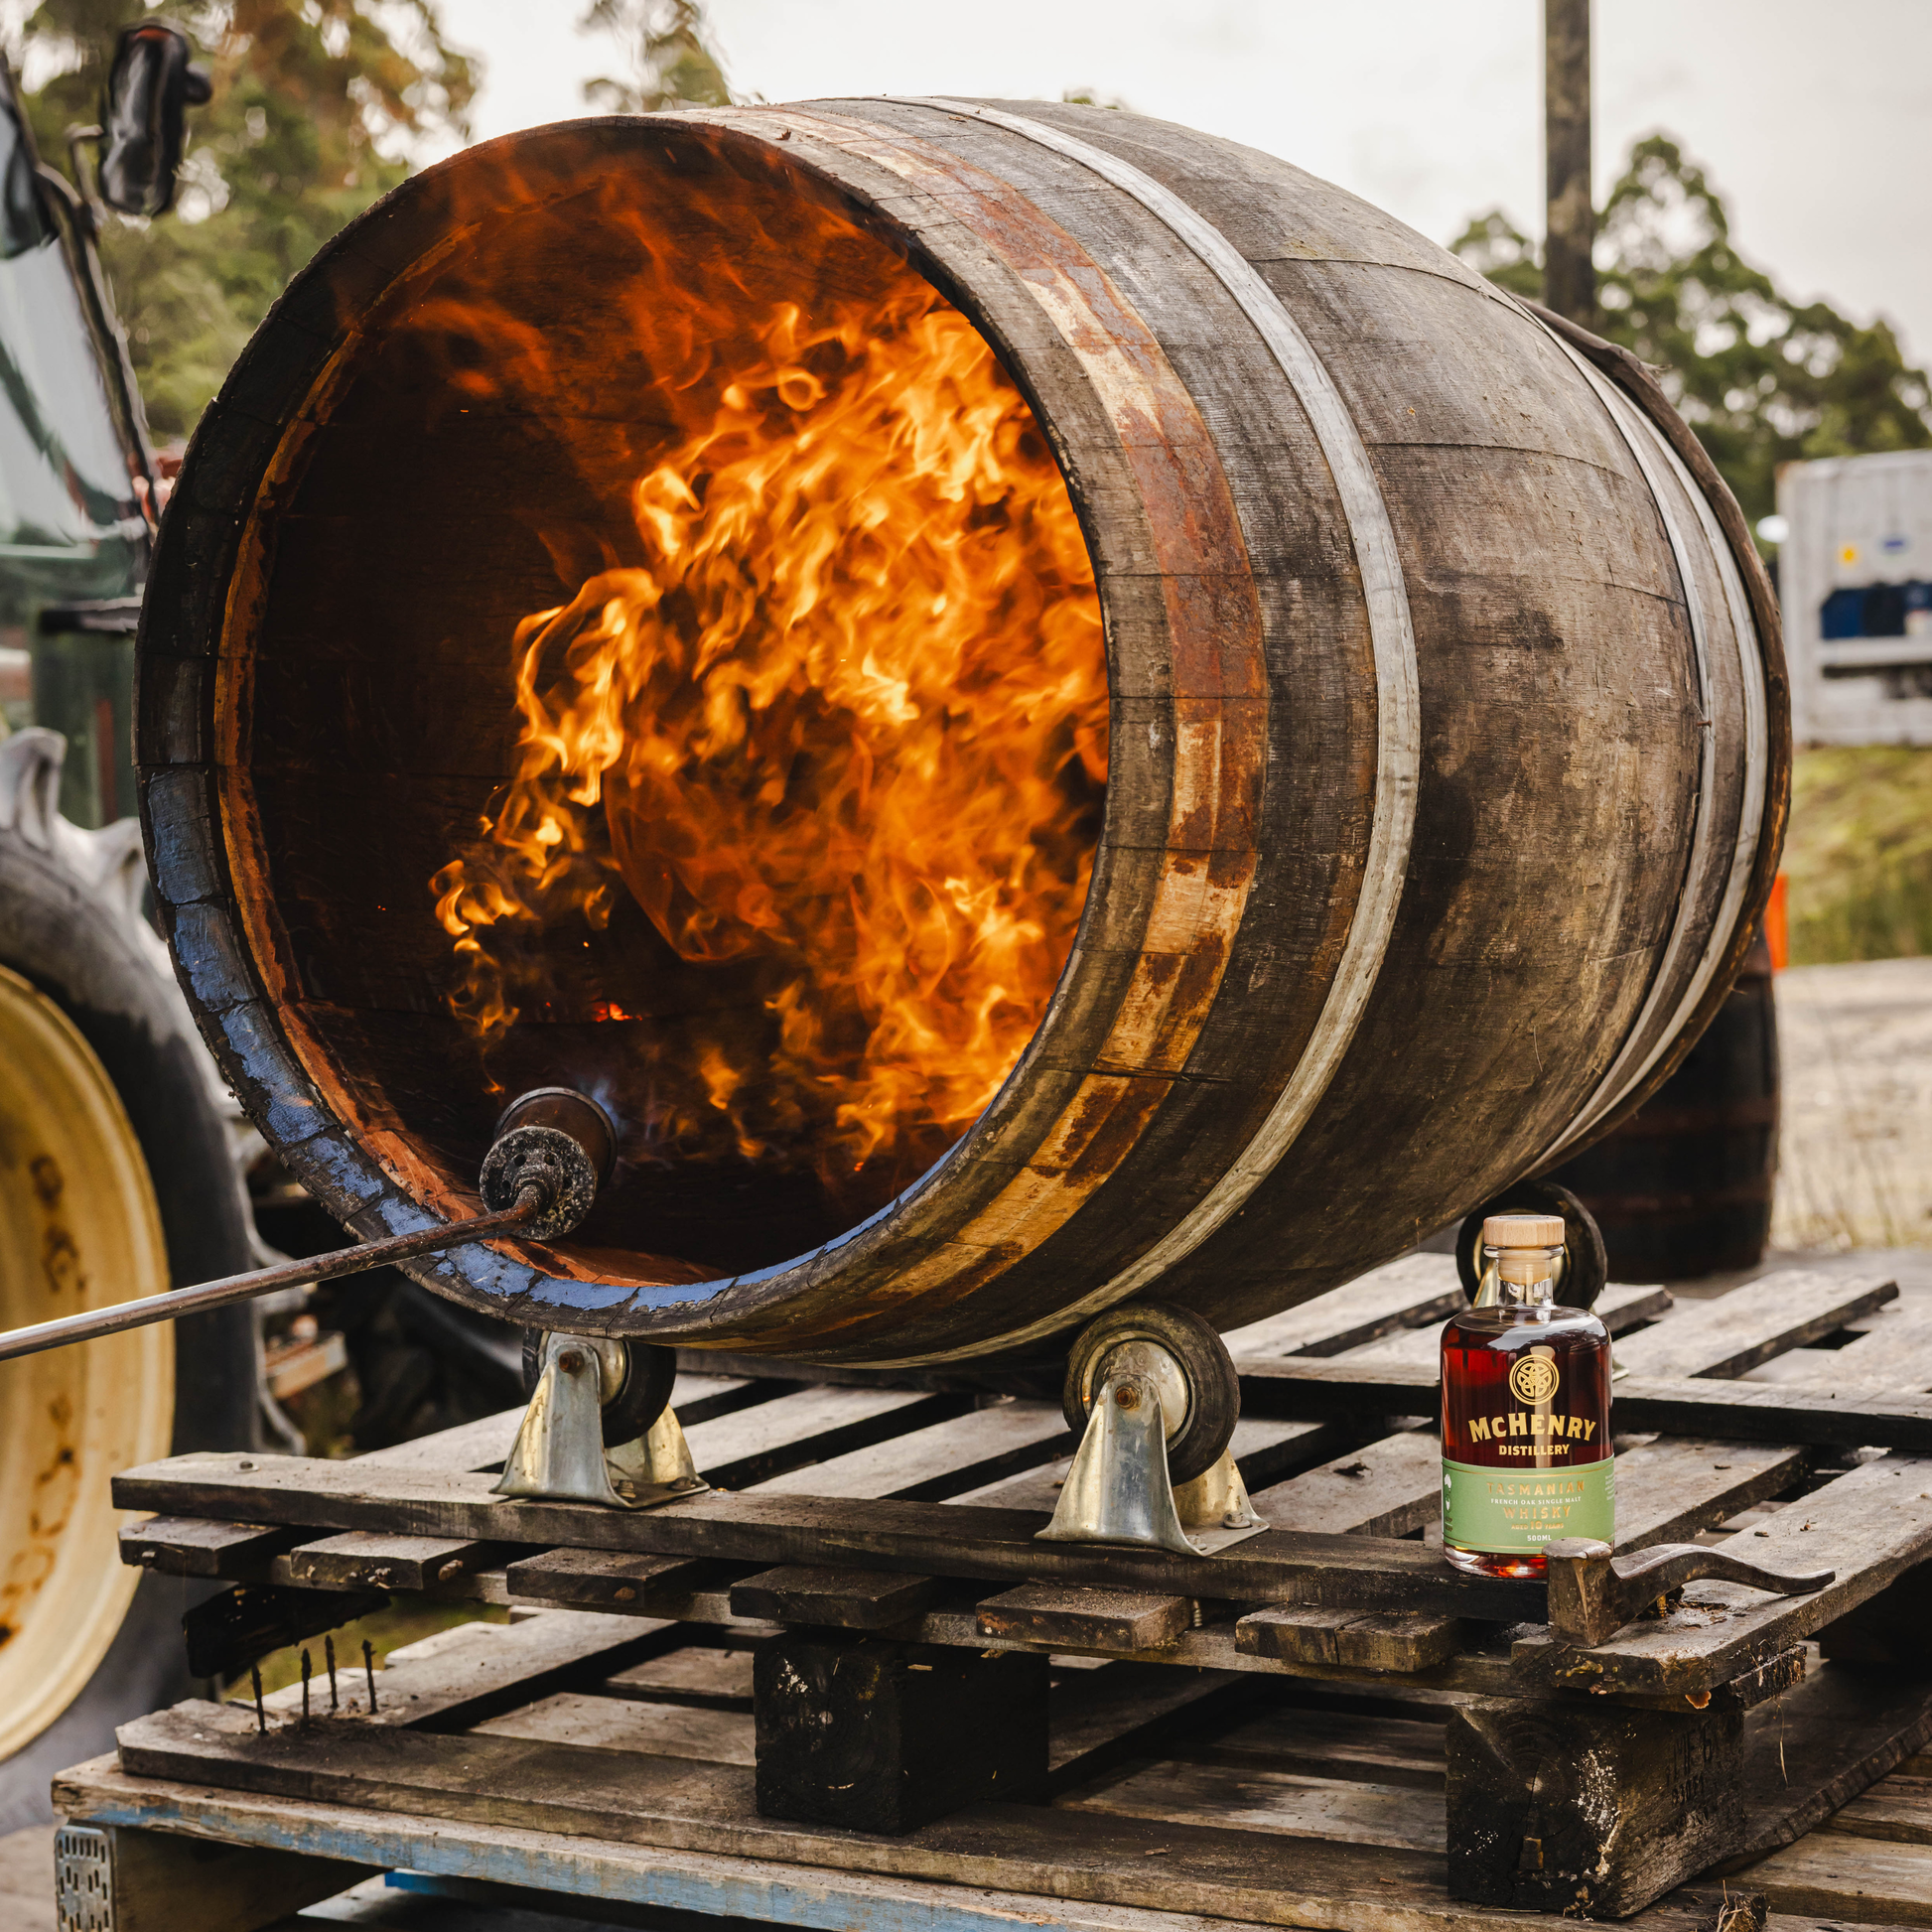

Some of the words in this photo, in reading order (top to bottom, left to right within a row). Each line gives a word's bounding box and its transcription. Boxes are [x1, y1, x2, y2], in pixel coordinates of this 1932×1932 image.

[1498, 1444, 1570, 1456] DISTILLERY
[1486, 1480, 1586, 1496] TASMANIAN
[1503, 1505, 1571, 1519] WHISKY
[1530, 1521, 1542, 1530] 10
